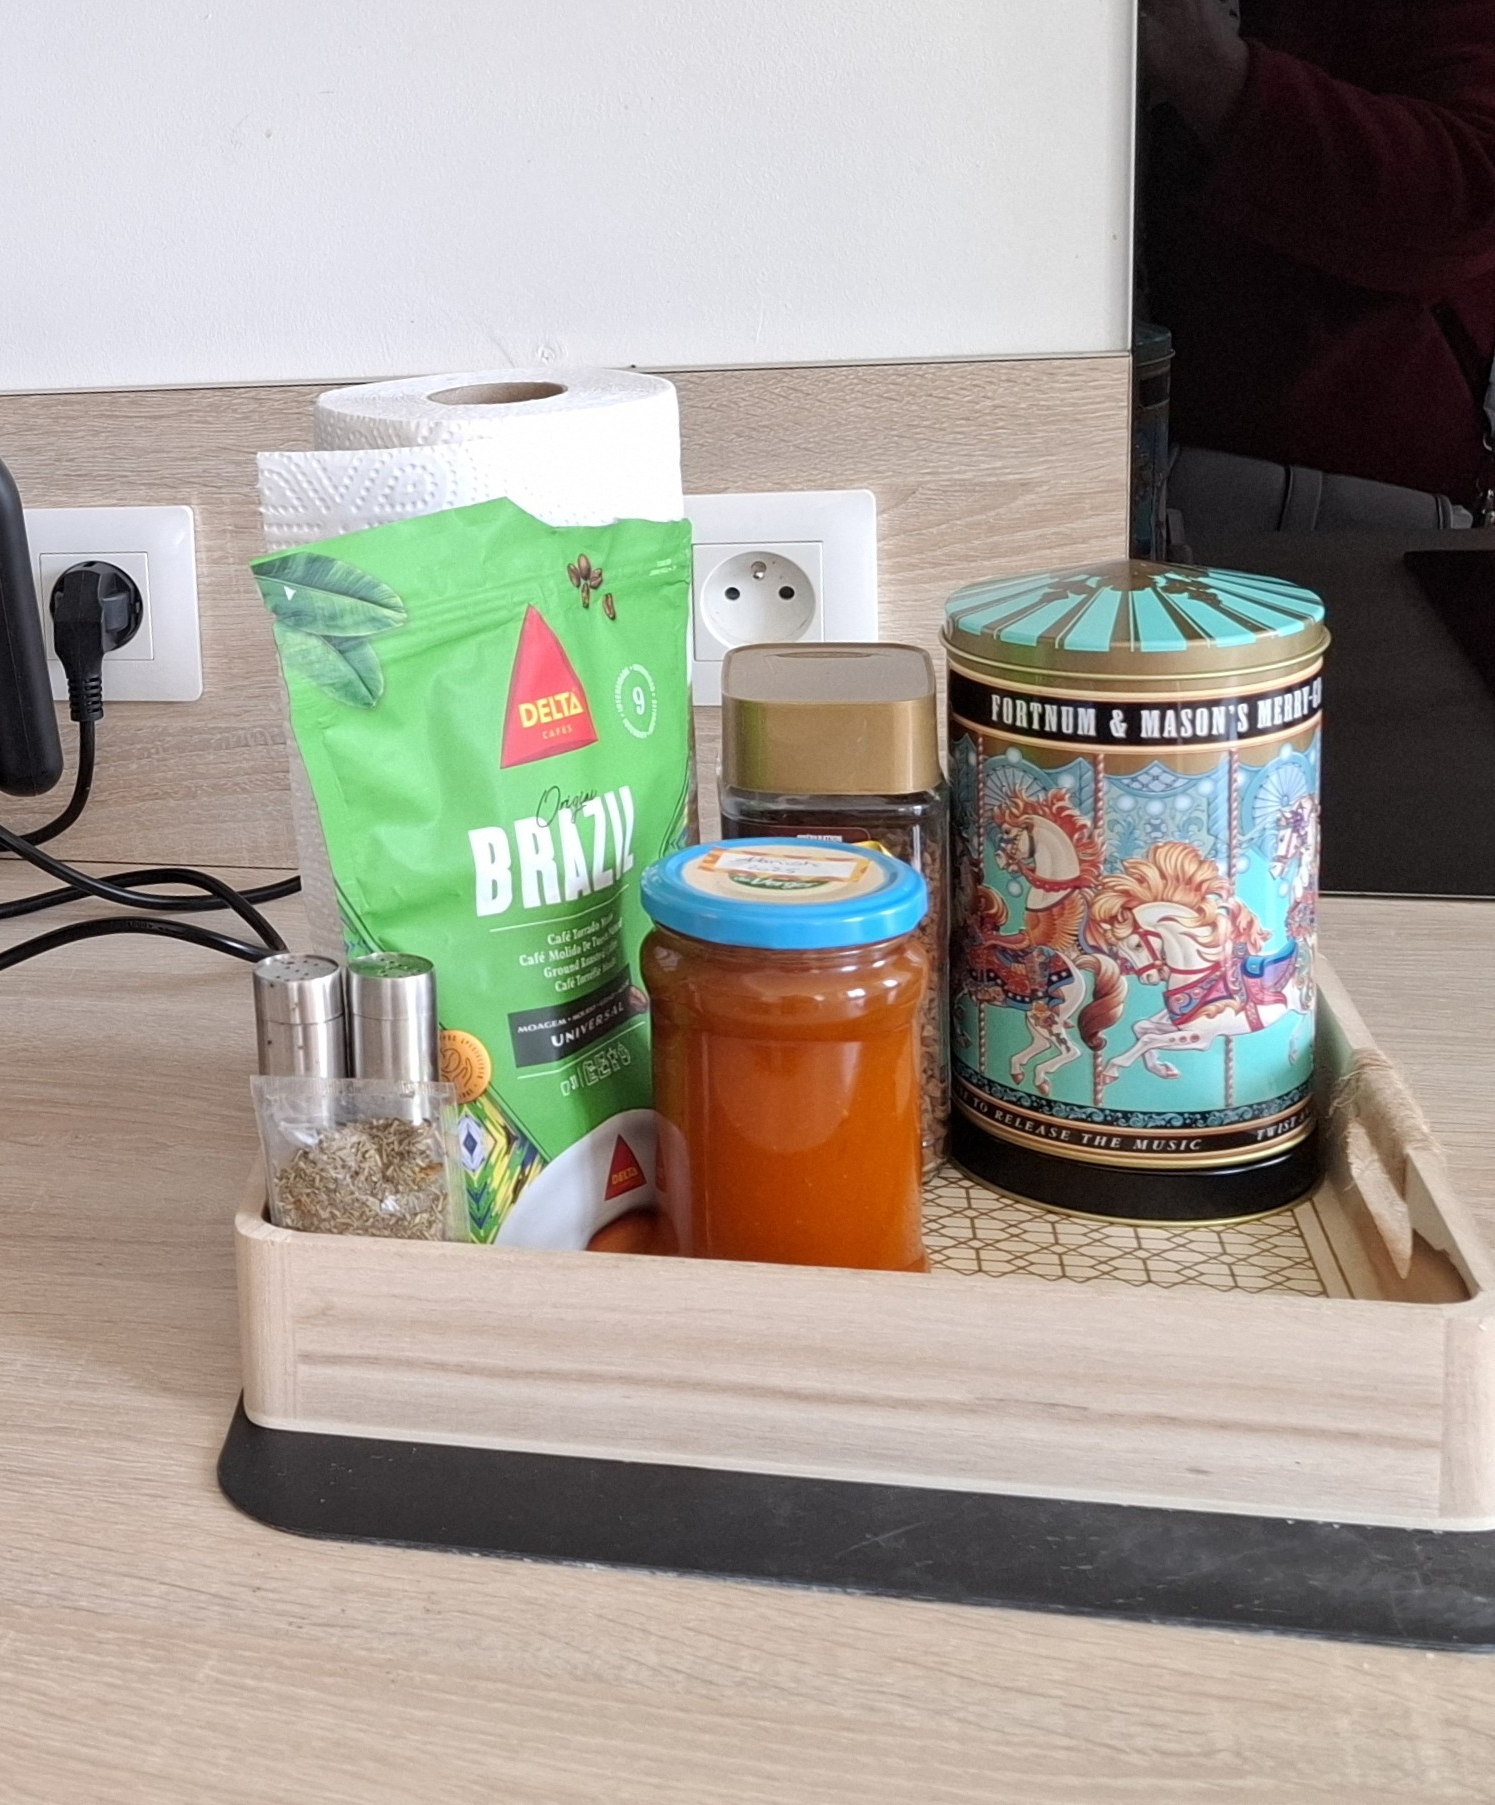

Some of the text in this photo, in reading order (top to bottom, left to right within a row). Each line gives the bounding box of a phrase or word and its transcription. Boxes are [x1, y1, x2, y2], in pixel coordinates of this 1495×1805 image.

[518, 691, 584, 728] DELTA
[632, 686, 645, 715] 9
[991, 694, 1097, 737] FORTNUM
[1109, 709, 1128, 738] &
[1140, 703, 1249, 739] MASON'S
[468, 785, 635, 917] BRAZIL
[547, 930, 572, 945] Café
[519, 951, 545, 967] Café
[555, 976, 576, 992] Café
[517, 1017, 567, 1034] MOAGEM
[551, 1001, 625, 1047] UNIVERSAL
[973, 1098, 1202, 1151] TO RELEASE THE MUSIC
[1257, 1115, 1297, 1141] TWIST
